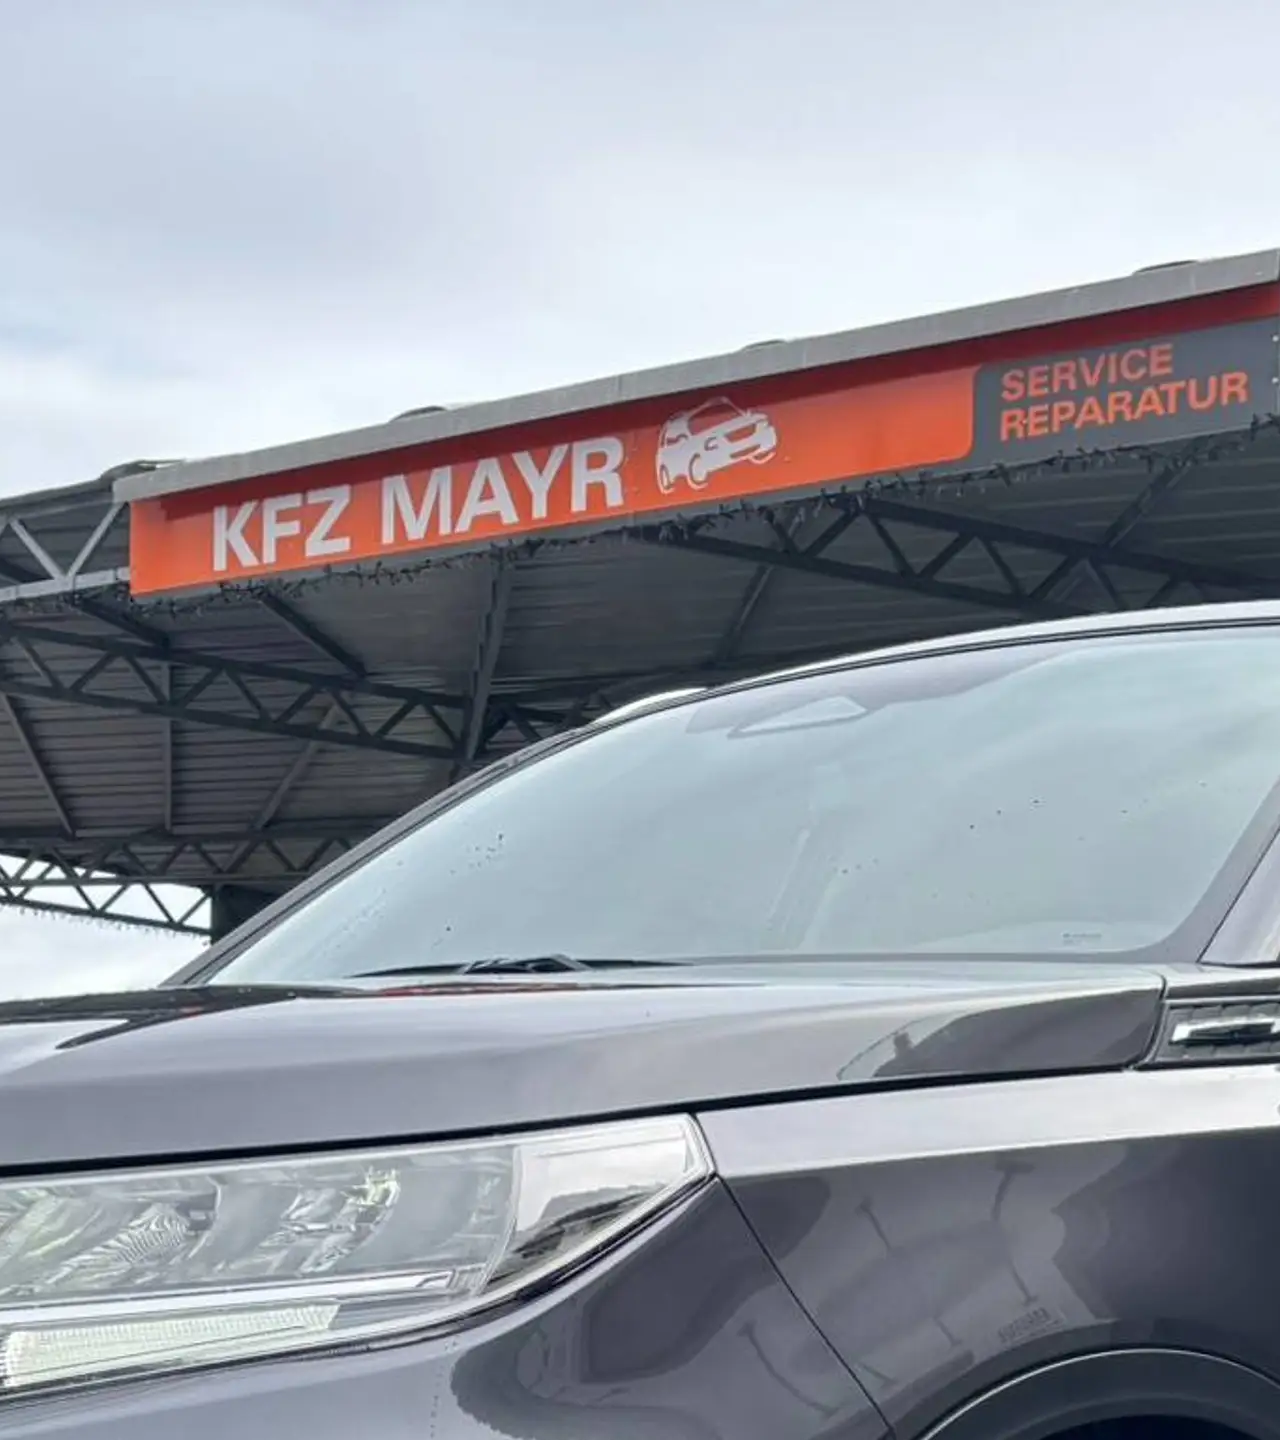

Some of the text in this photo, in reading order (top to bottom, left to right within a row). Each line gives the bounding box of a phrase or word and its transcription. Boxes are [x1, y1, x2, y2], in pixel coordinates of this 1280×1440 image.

[999, 371, 1248, 442] REPARATUR
[1001, 343, 1175, 401] SERVICE
[213, 435, 625, 572] KFZ MAYR
